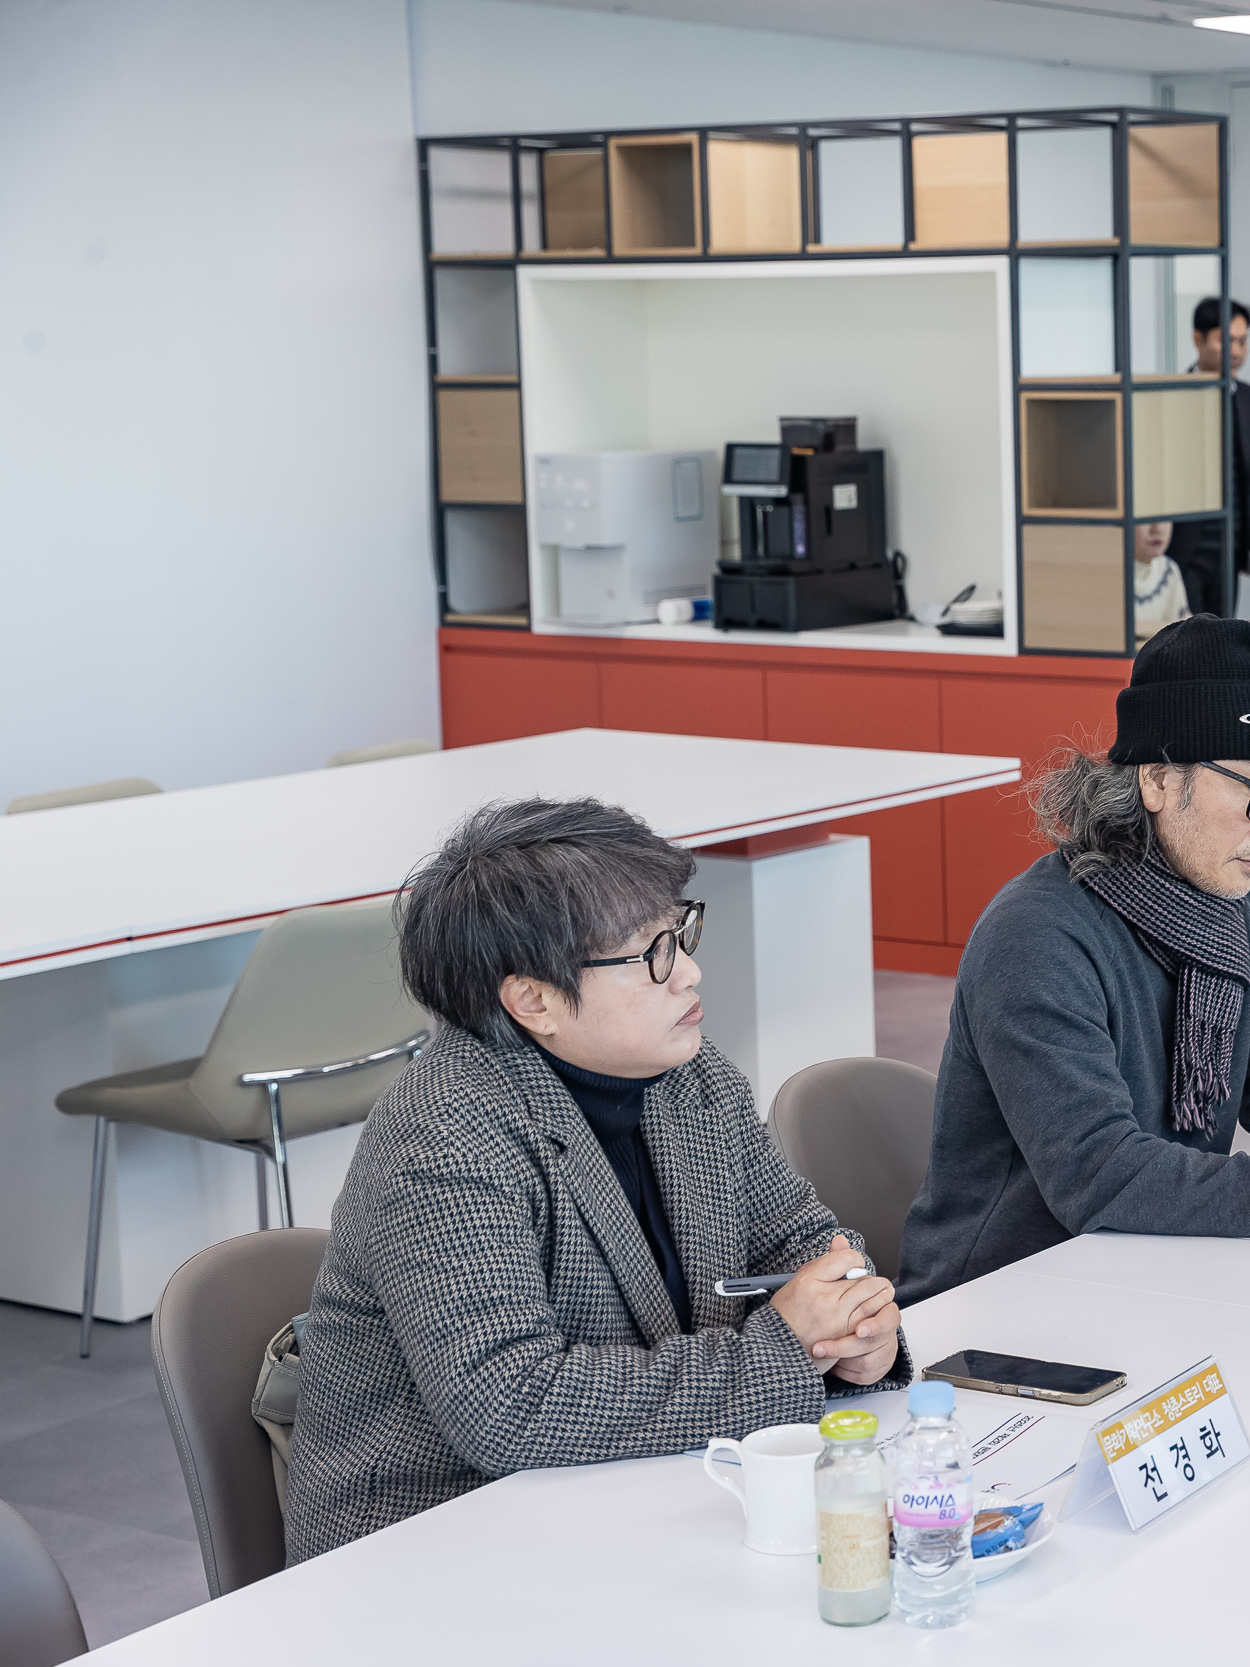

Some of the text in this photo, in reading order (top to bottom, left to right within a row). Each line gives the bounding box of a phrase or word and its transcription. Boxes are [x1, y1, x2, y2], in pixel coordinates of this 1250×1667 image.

[1103, 1372, 1223, 1458] 문화기획연구소 청춘스토리 대표
[1138, 1418, 1226, 1503] 전경화
[902, 1494, 956, 1510] 아이시스
[938, 1508, 956, 1520] 8.0
